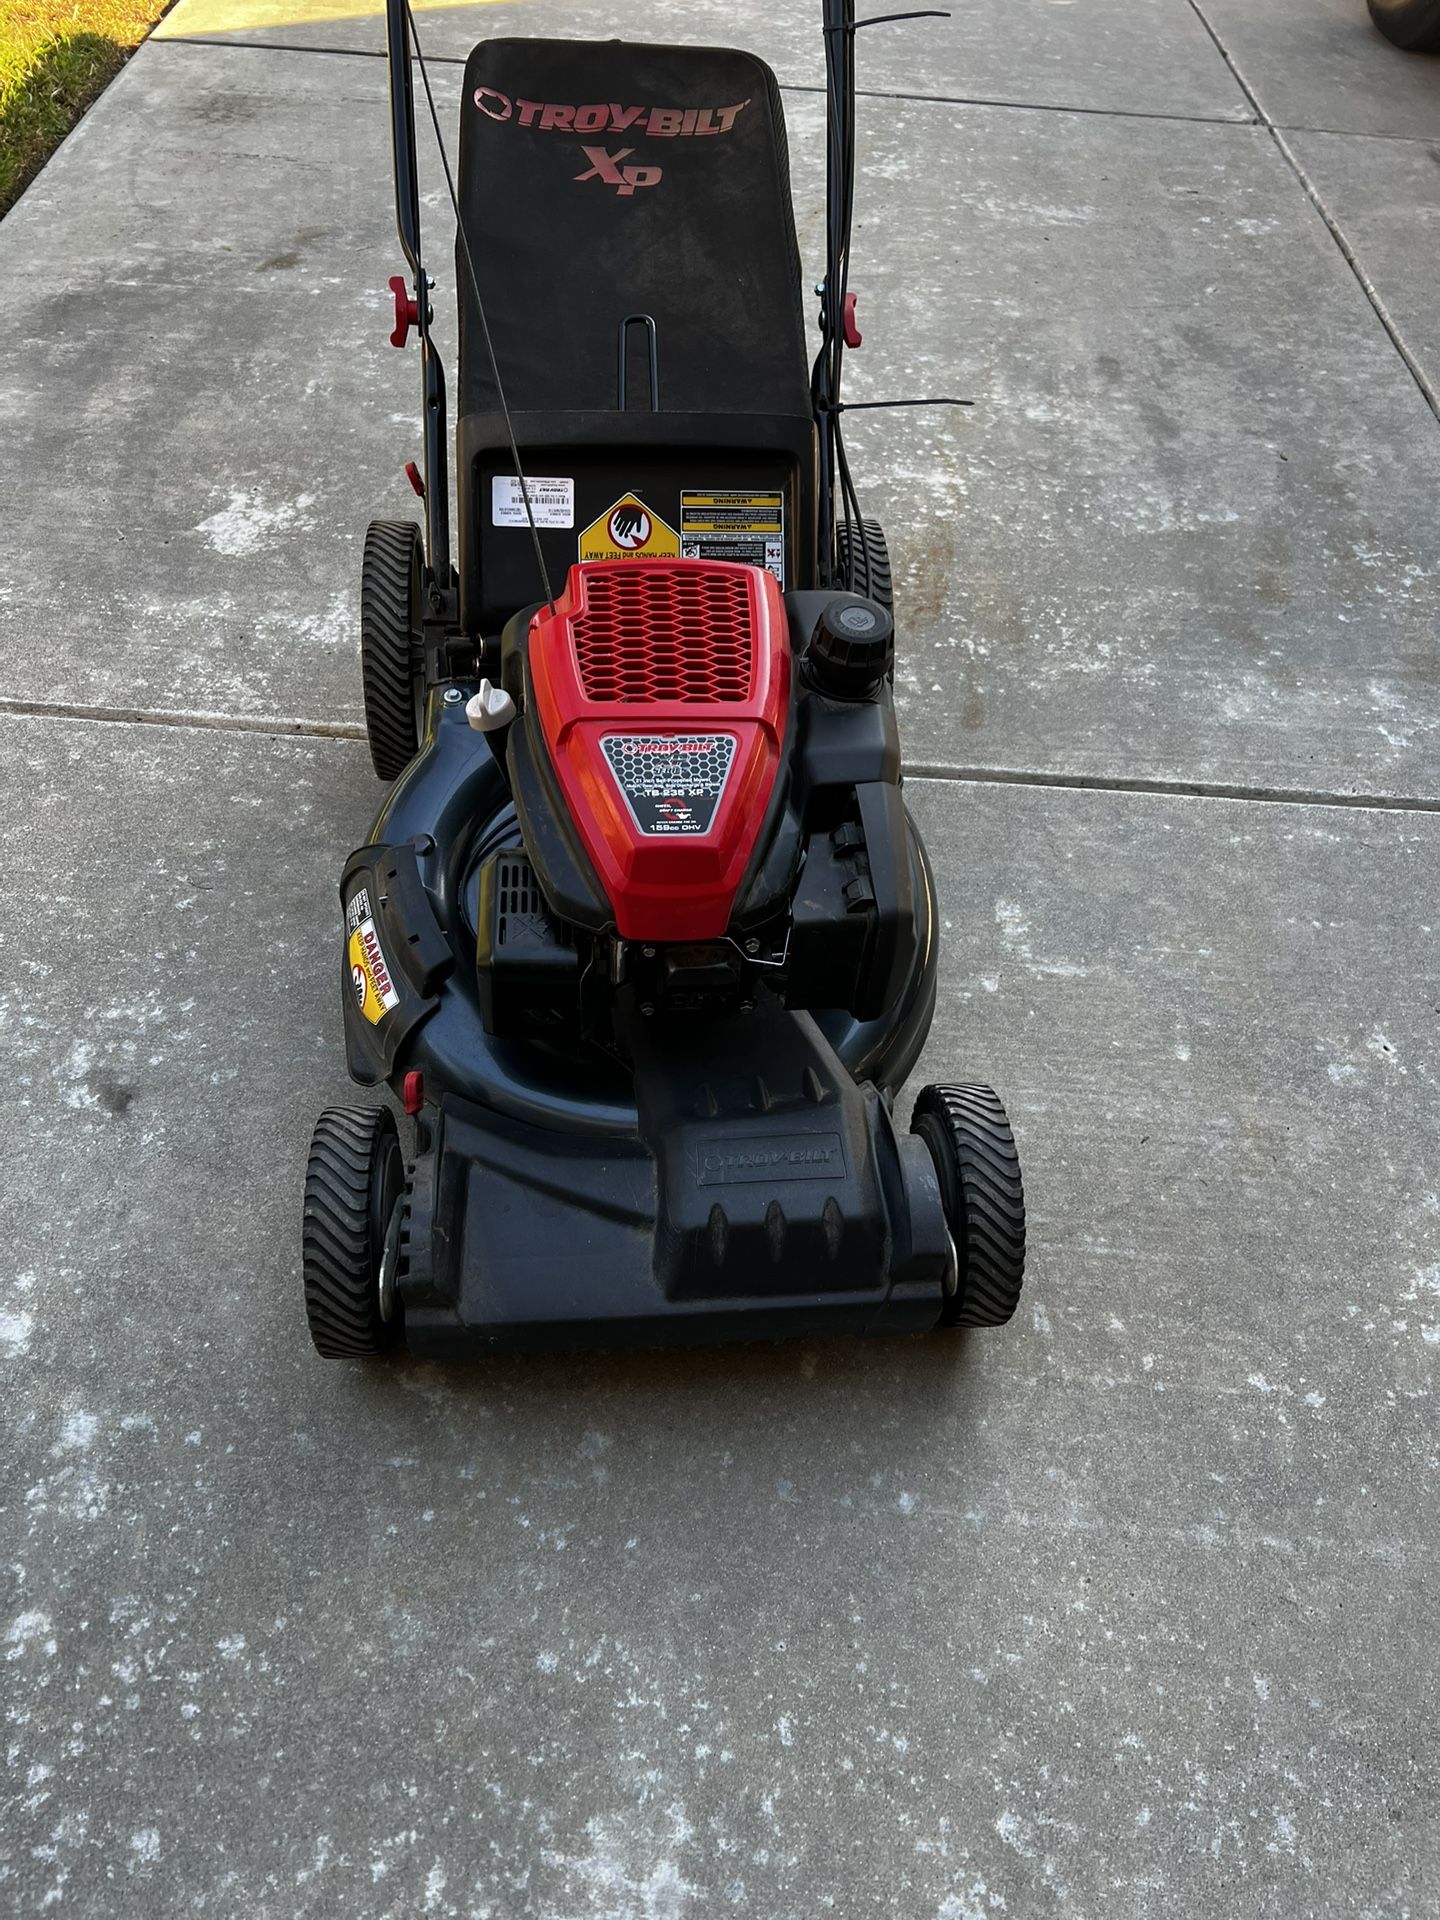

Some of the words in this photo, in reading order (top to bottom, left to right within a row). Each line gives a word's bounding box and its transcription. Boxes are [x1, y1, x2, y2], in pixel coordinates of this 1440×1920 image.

[516, 98, 746, 137] TROY-BILT
[584, 552, 604, 560] AWAY
[605, 552, 621, 560] FEET
[638, 742, 714, 754] TROY-BILT
[364, 930, 392, 997] DANGER
